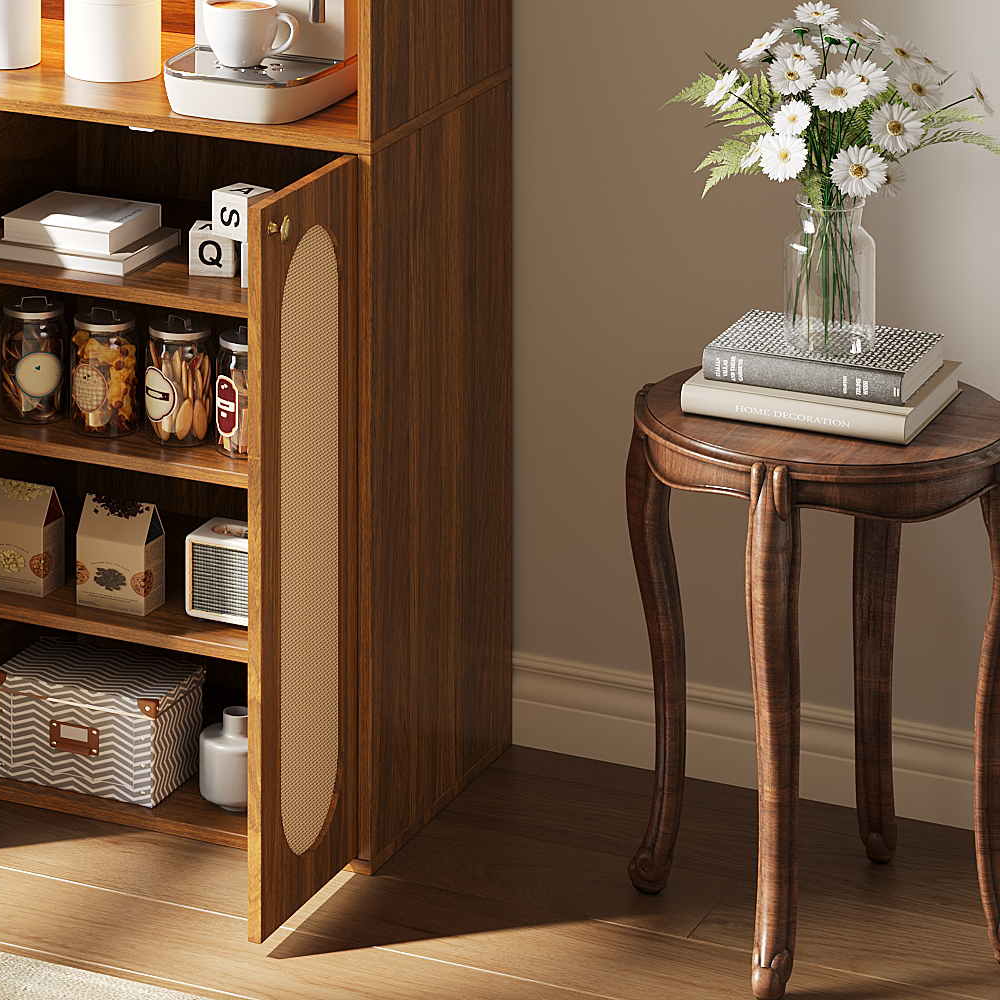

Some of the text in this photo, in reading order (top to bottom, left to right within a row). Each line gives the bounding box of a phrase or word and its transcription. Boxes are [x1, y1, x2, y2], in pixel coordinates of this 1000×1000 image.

[229, 187, 255, 195] A
[220, 206, 240, 228] S
[198, 240, 223, 269] Q
[735, 404, 850, 429] HOME DECORATION
